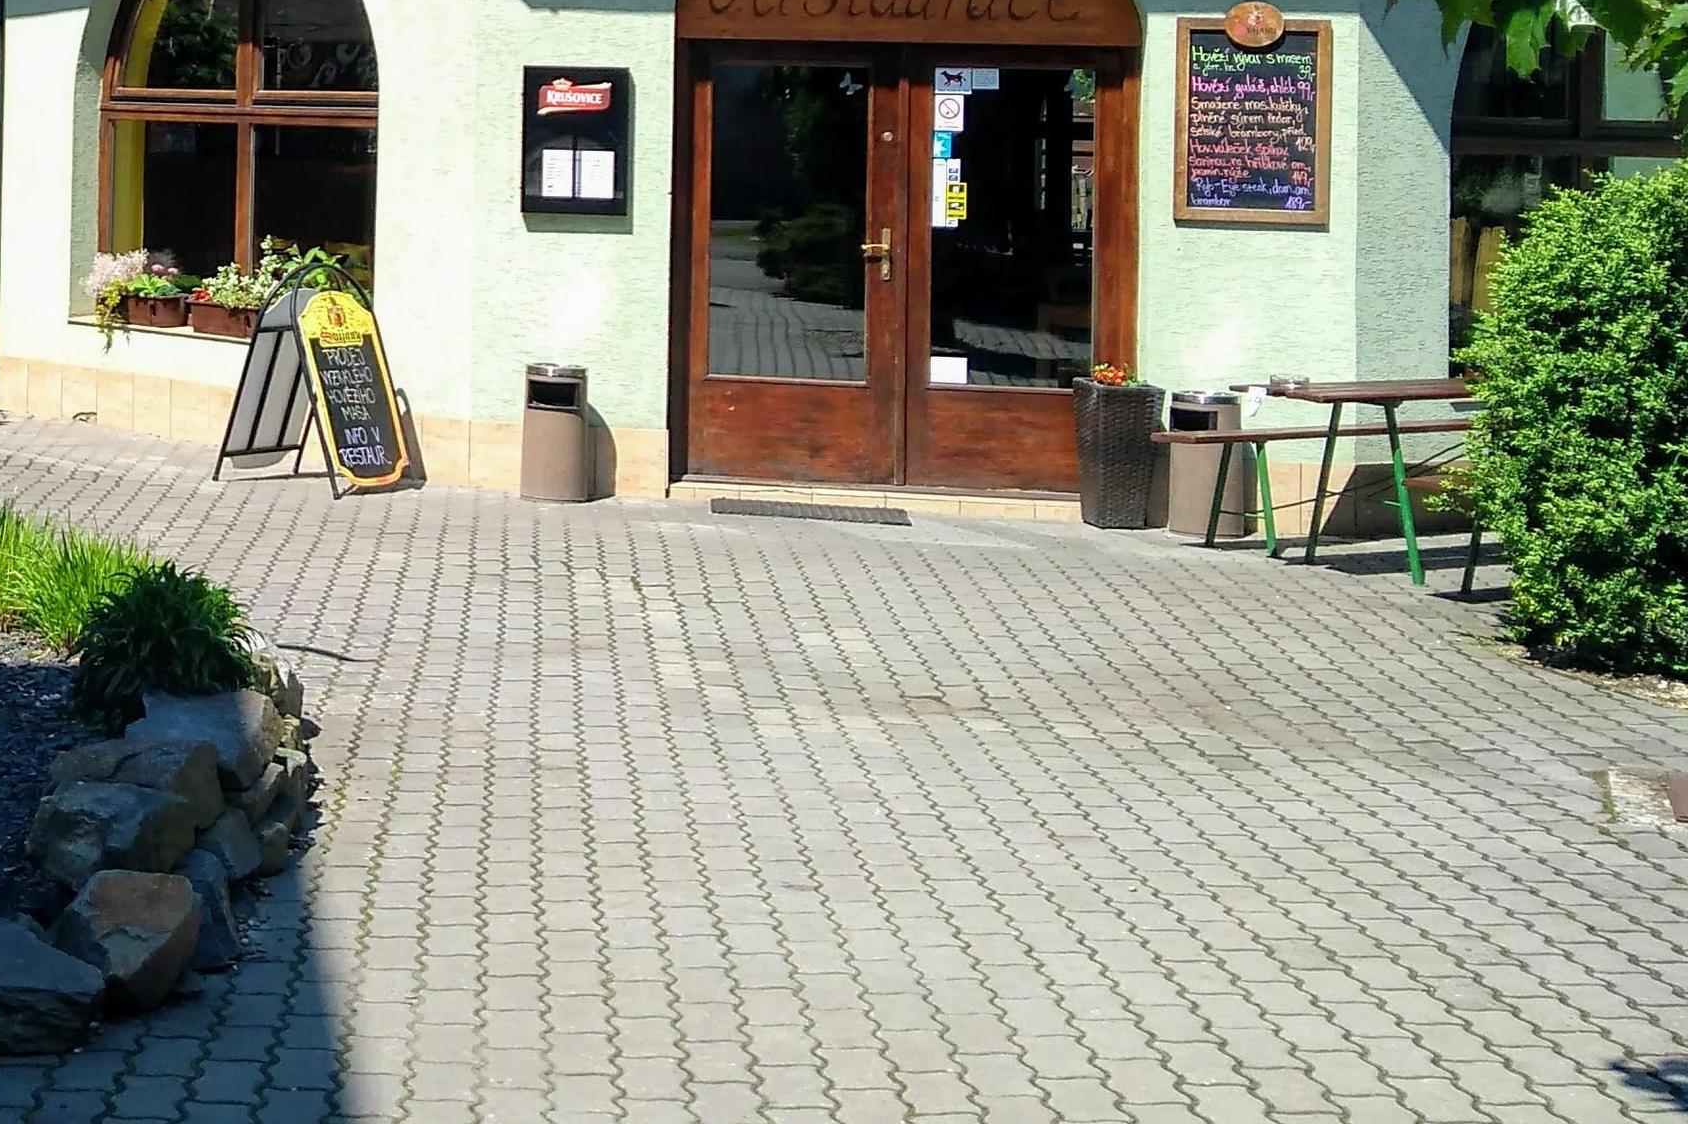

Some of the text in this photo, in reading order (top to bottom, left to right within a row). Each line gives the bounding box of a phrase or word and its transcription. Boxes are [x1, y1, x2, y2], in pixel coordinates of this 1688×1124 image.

[1192, 46, 1230, 62] Hovězí
[1192, 76, 1232, 92] Hovězí
[1191, 96, 1242, 110] Smažené
[1230, 112, 1264, 129] sýrem
[322, 347, 366, 366] PRODEJ
[341, 406, 371, 421] MASA
[344, 426, 380, 444] INFO V
